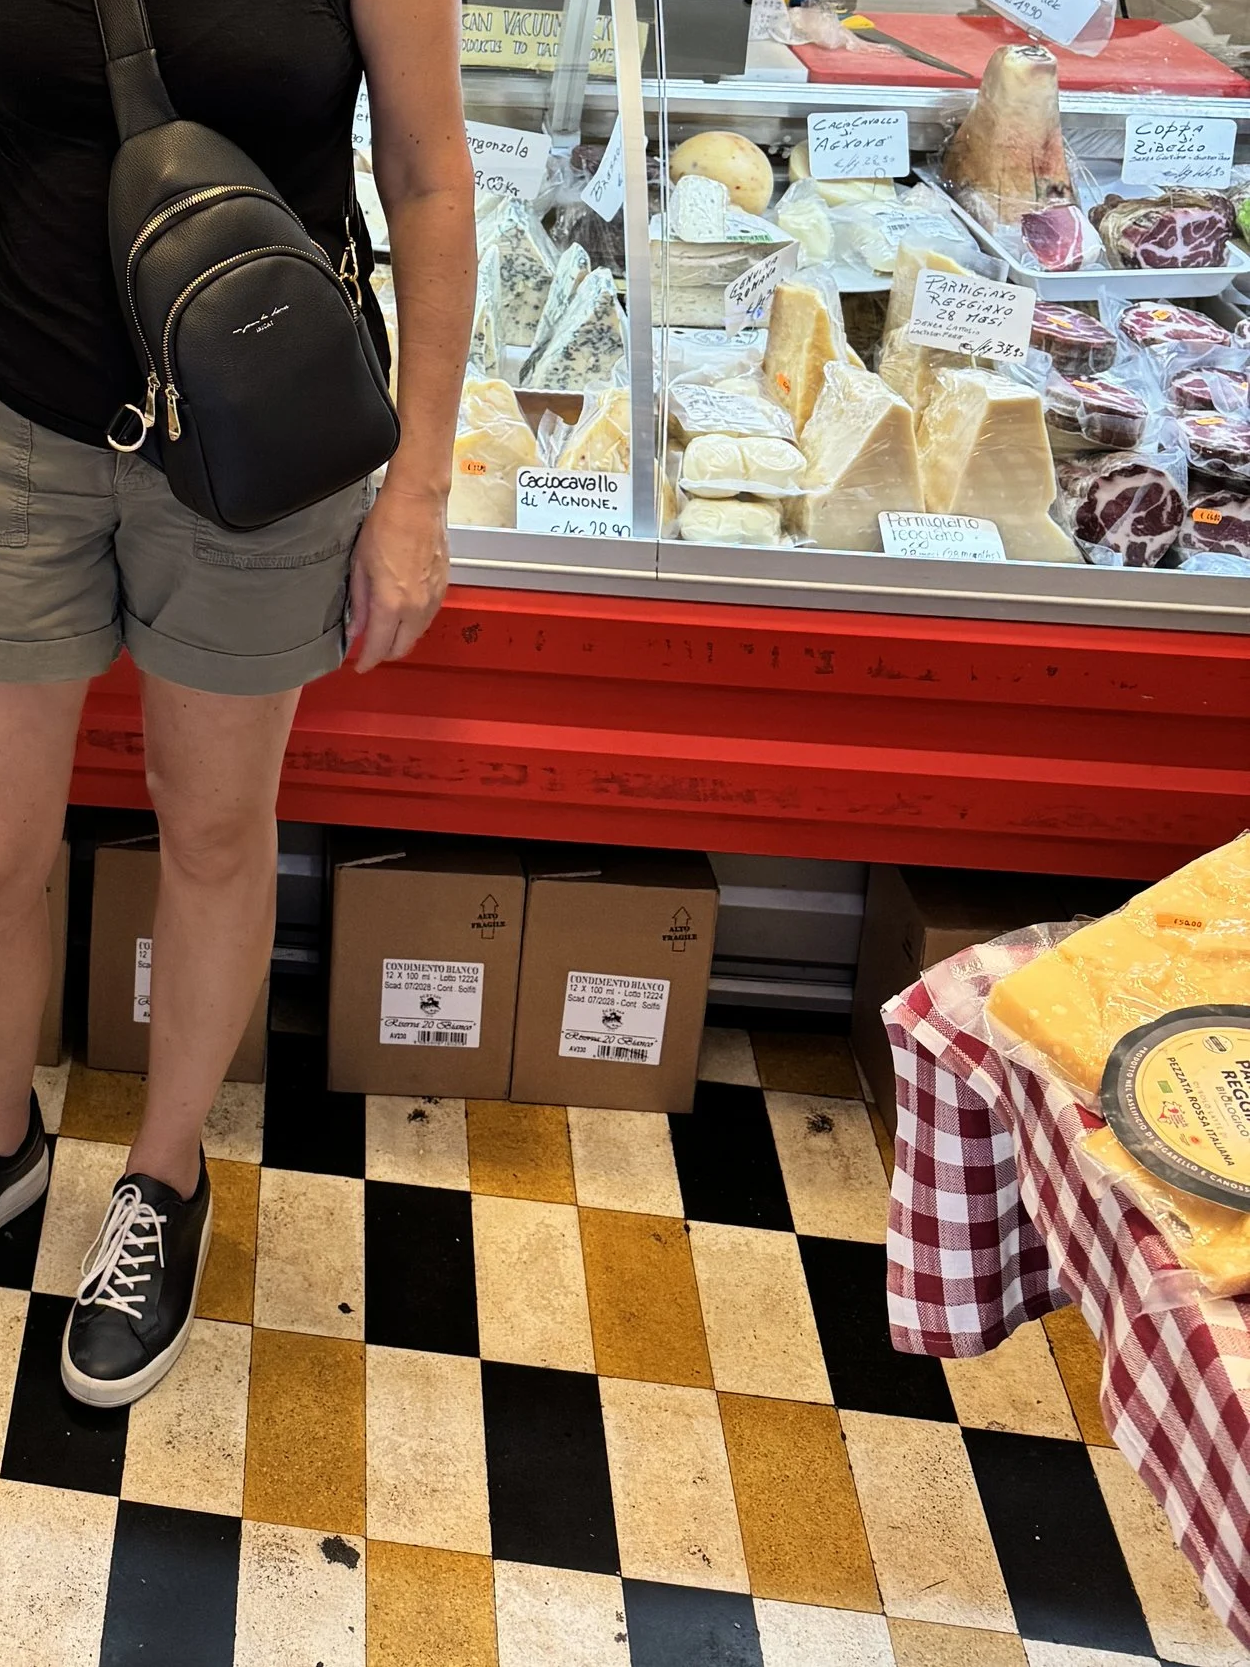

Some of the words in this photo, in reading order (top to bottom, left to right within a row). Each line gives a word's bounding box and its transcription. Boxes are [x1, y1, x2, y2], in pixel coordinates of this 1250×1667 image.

[518, 470, 618, 493] Caciocavallo
[521, 491, 539, 508] di
[886, 512, 979, 530] Parmigiano
[471, 921, 507, 929] FRAGILE
[662, 933, 698, 941] FRAGILE
[385, 962, 445, 973] CONDIMENTO
[446, 965, 479, 975] BIANCO
[386, 971, 393, 979] 12
[458, 975, 479, 983] 12224
[570, 975, 631, 989] CONDIMENTO
[631, 981, 665, 992] BIANCO
[570, 984, 578, 992] 12
[590, 986, 603, 994] 100
[643, 991, 663, 1000] 12224
[1165, 1056, 1194, 1096] PEZZATA
[1187, 1095, 1212, 1129] ROSSA
[1204, 1126, 1237, 1168] ITALIANA
[1215, 1085, 1250, 1138] BIOLOGICO
